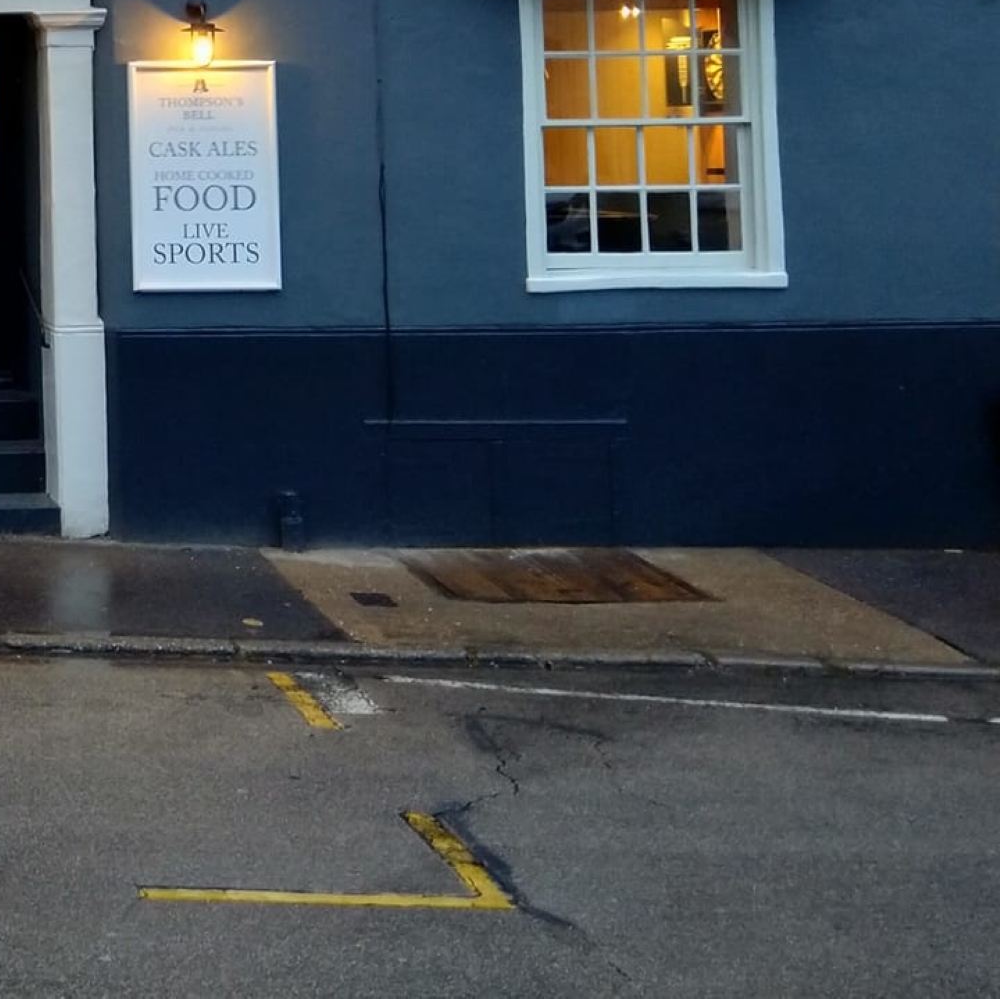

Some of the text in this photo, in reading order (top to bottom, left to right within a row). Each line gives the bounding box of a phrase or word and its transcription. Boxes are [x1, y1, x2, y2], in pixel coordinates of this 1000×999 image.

[183, 110, 215, 120] BELL
[149, 140, 258, 157] CASK ALES
[154, 170, 254, 182] HOME COOKED
[152, 185, 256, 212] FOOD
[183, 223, 229, 239] LIVE
[153, 242, 259, 265] SPORTS
